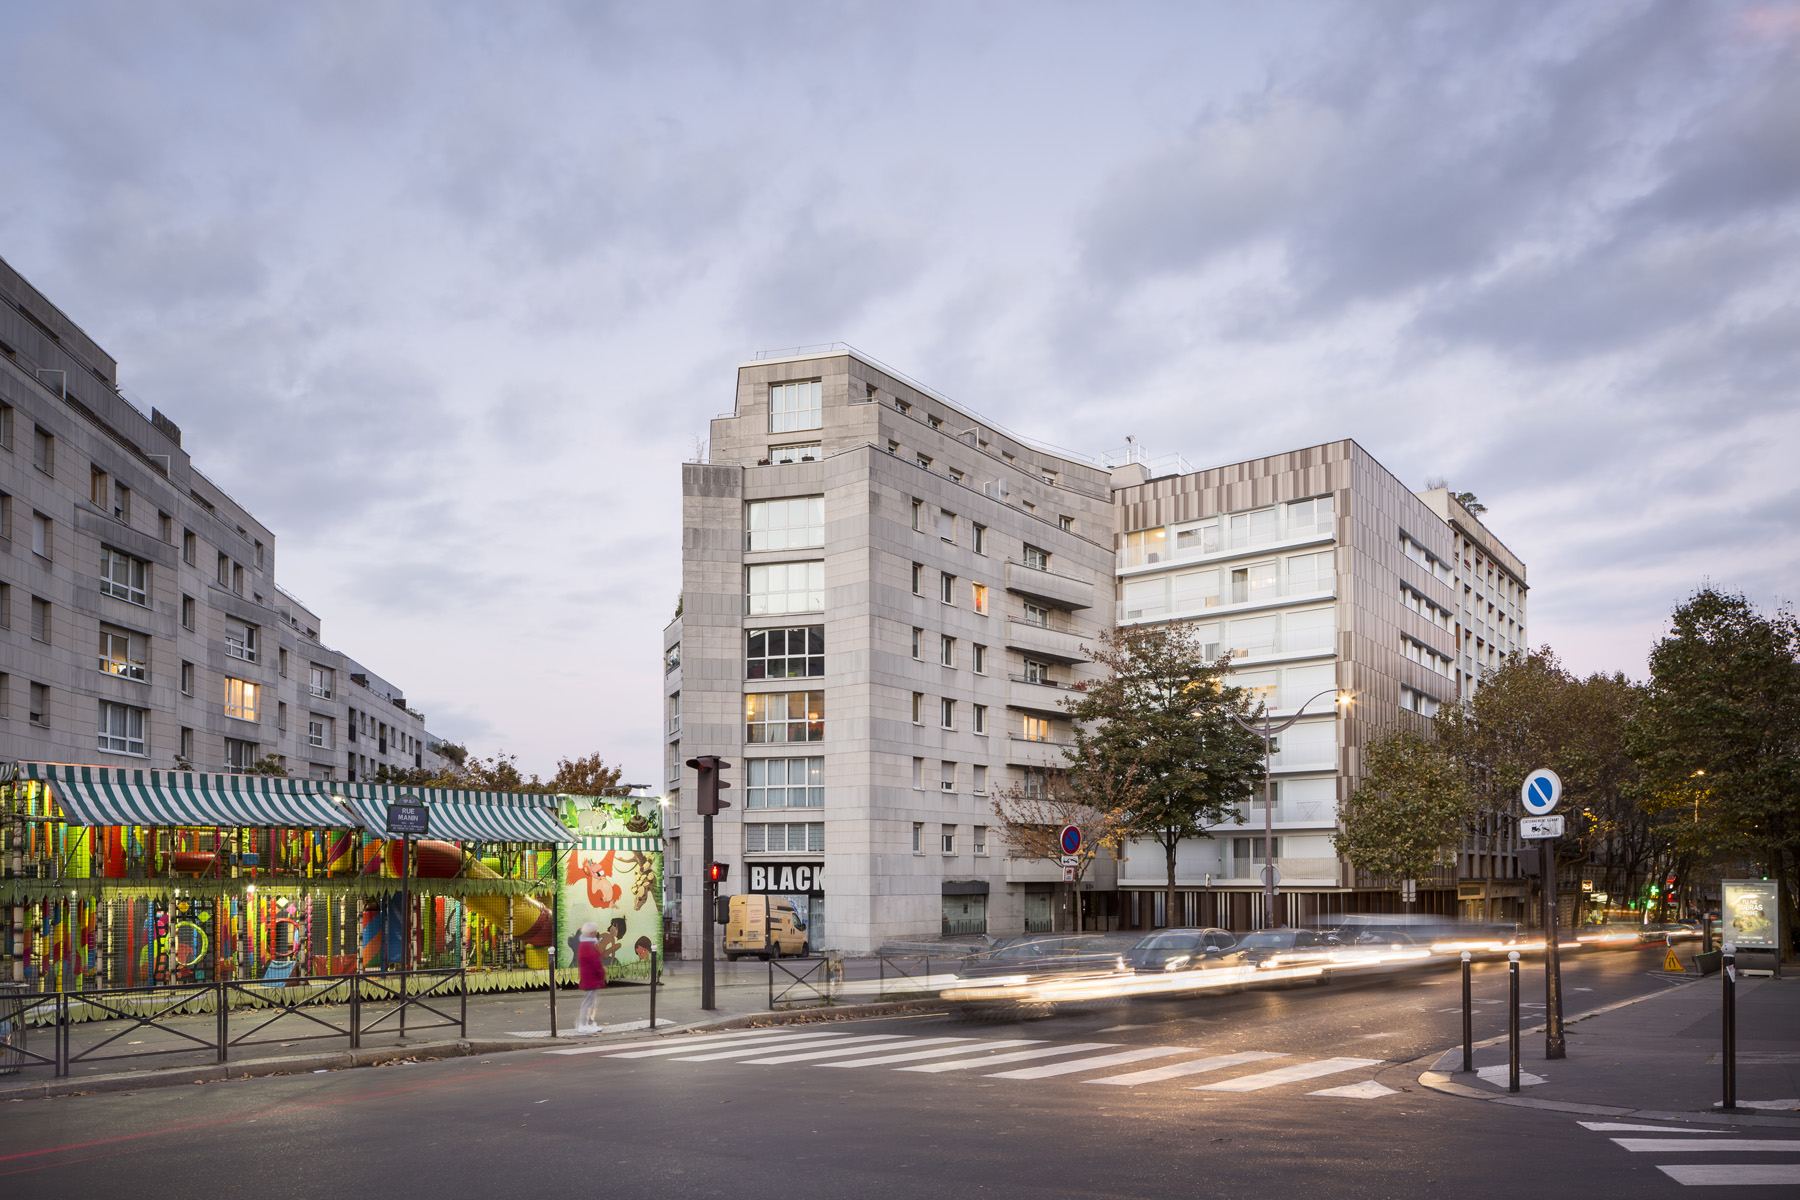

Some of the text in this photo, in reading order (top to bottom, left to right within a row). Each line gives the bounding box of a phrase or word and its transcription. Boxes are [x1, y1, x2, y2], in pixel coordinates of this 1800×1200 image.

[401, 807, 415, 815] RUE
[397, 814, 419, 822] MANIN
[751, 866, 825, 891] BLACK
